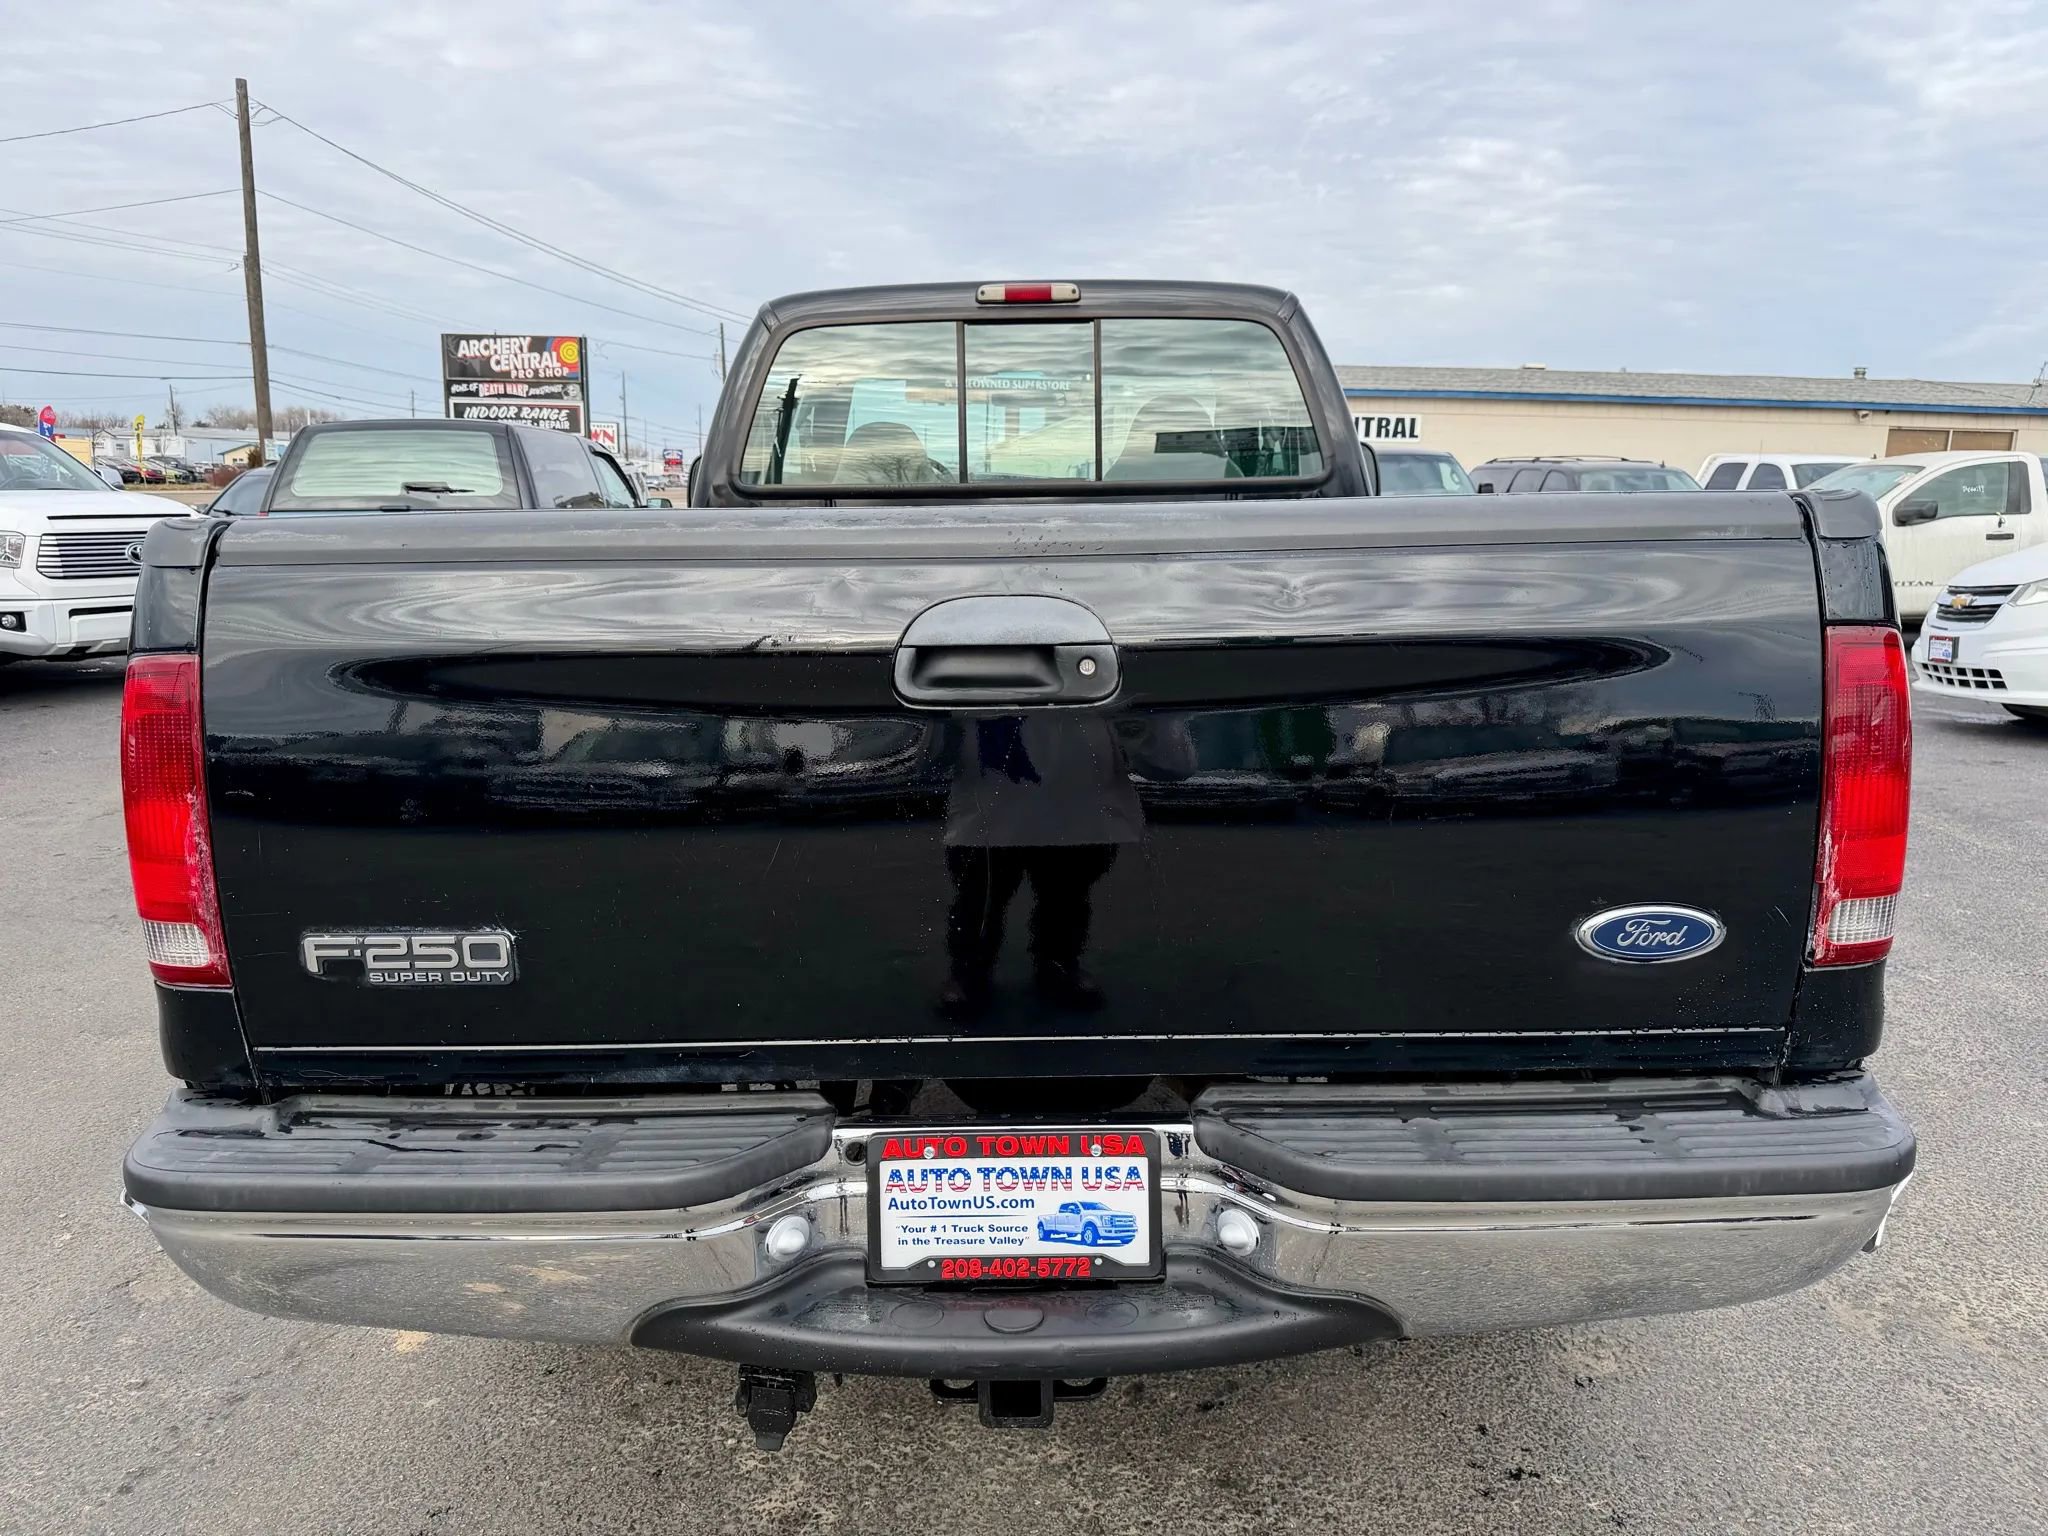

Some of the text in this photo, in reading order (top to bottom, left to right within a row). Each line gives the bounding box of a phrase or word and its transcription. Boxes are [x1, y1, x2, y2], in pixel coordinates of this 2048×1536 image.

[457, 337, 531, 357] ARCHERY
[489, 352, 561, 372] CENTRAL
[510, 367, 569, 379] PRO SHOP
[479, 381, 505, 397] DEATH
[1013, 380, 1072, 391] SUPERSTORE
[463, 405, 570, 421] INDOOR RANGE
[539, 420, 570, 430] REPAIR
[1617, 918, 1689, 947] Ford
[303, 935, 509, 973] F-250
[369, 971, 510, 982] SUPER DUTY
[882, 1135, 1146, 1158] AUTO TOWN USA
[885, 1165, 1146, 1193] AUTO TOWN USA
[887, 1195, 1035, 1211] AutoTownUS.com
[930, 1225, 937, 1233] #
[941, 1225, 947, 1233] 1
[951, 1224, 984, 1233] Truck
[988, 1223, 1029, 1233] Source
[897, 1237, 908, 1246] in
[911, 1237, 931, 1246] the
[934, 1236, 986, 1245] Treasure
[941, 1257, 1091, 1279] 208-402-5772
